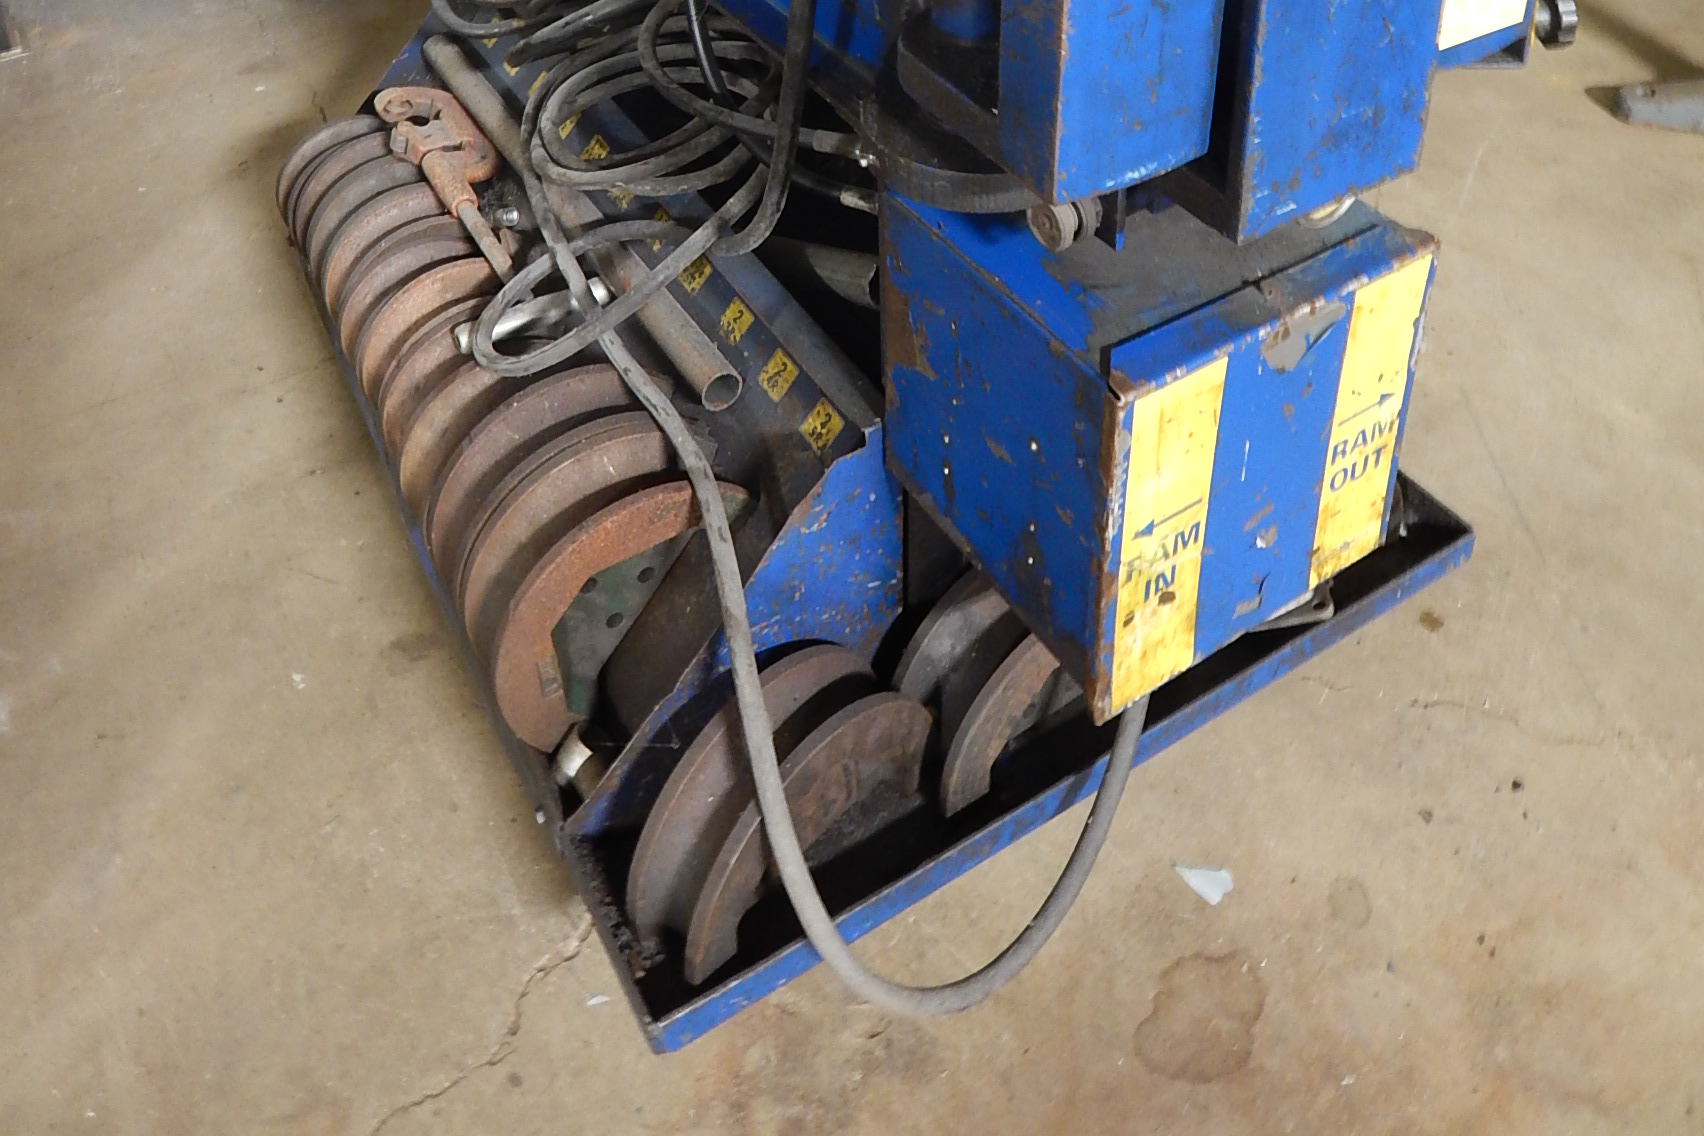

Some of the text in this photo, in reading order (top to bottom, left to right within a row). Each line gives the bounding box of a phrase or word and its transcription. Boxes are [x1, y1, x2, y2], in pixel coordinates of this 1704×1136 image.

[732, 309, 744, 324] 2
[1331, 415, 1398, 466] RAM
[1330, 443, 1388, 492] OUT
[1143, 563, 1176, 604] IN
